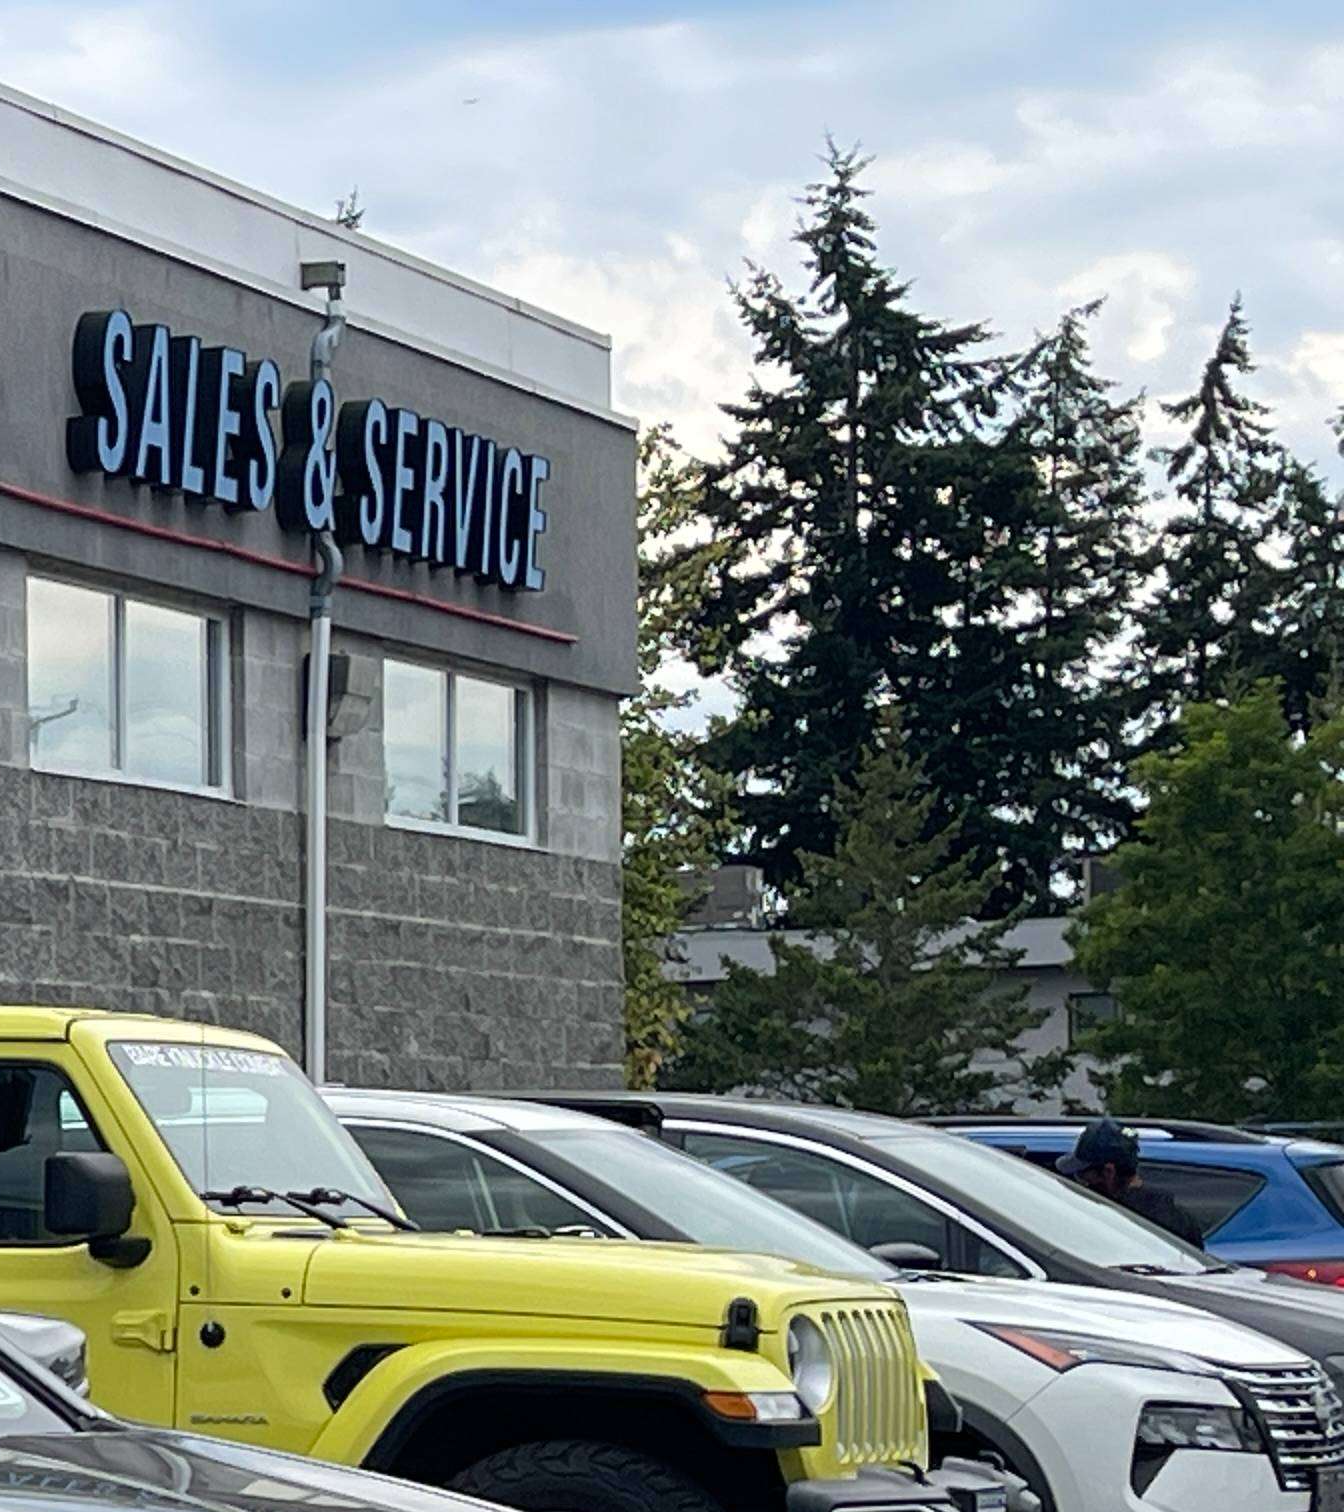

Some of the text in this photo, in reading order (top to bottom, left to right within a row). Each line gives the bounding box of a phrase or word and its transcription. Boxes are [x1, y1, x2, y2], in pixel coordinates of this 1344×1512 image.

[94, 308, 550, 592] SALES & SERVICE
